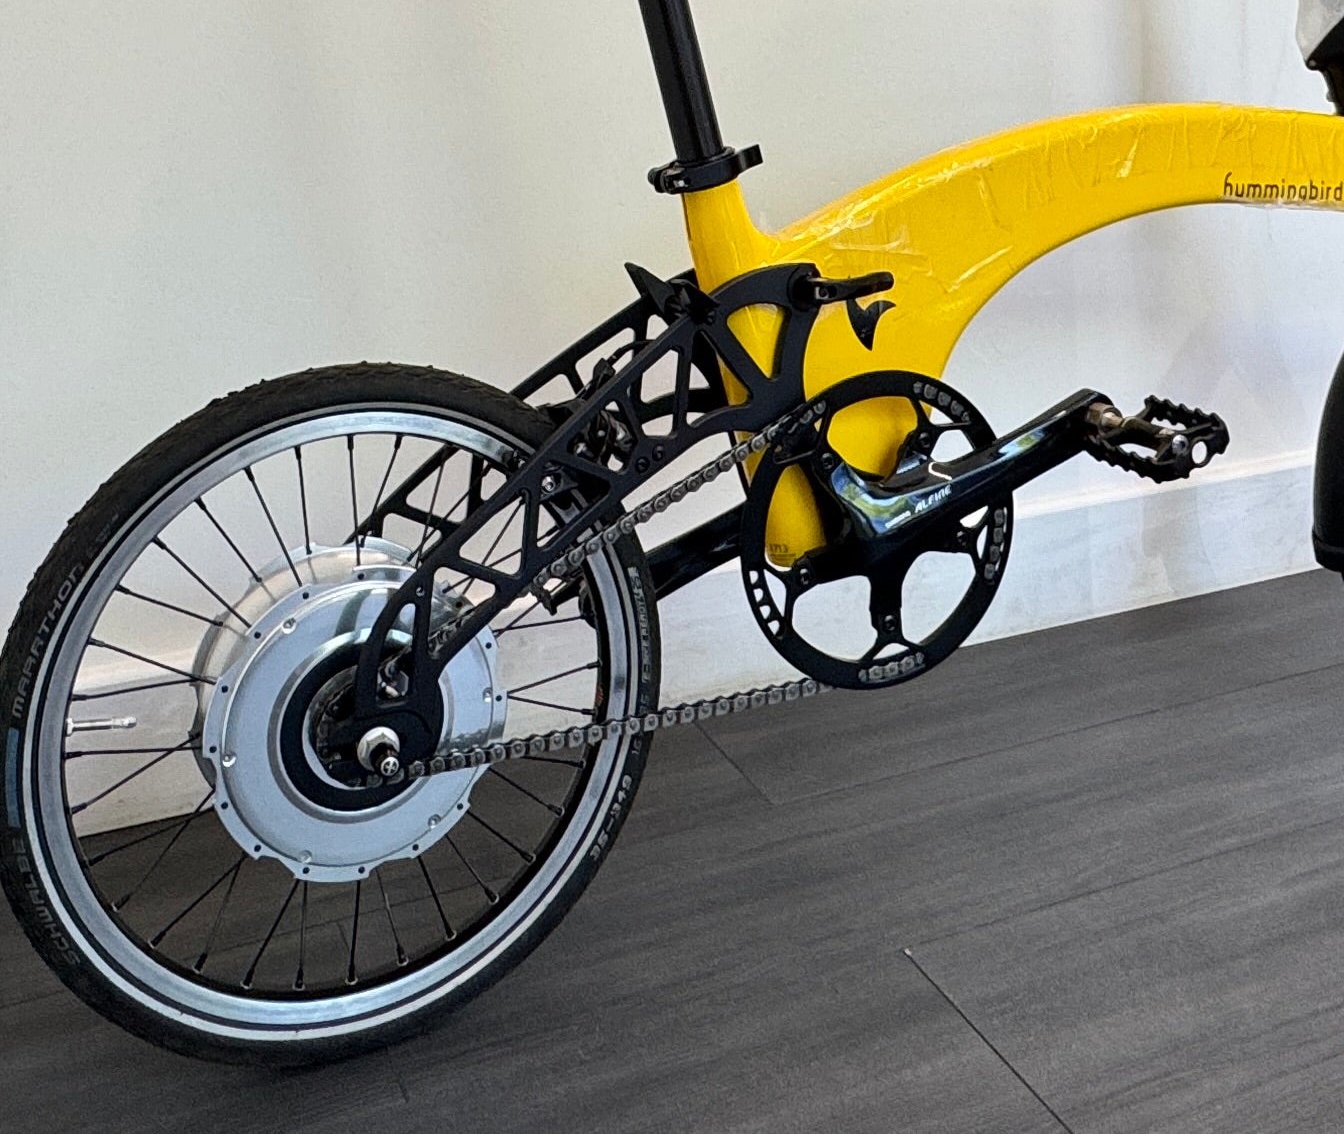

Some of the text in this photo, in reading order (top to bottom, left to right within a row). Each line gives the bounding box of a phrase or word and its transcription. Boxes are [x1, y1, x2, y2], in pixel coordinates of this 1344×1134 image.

[1223, 171, 1344, 202] hummingbird
[11, 563, 85, 719] MARATHON
[11, 836, 82, 966] SCHWALBE
